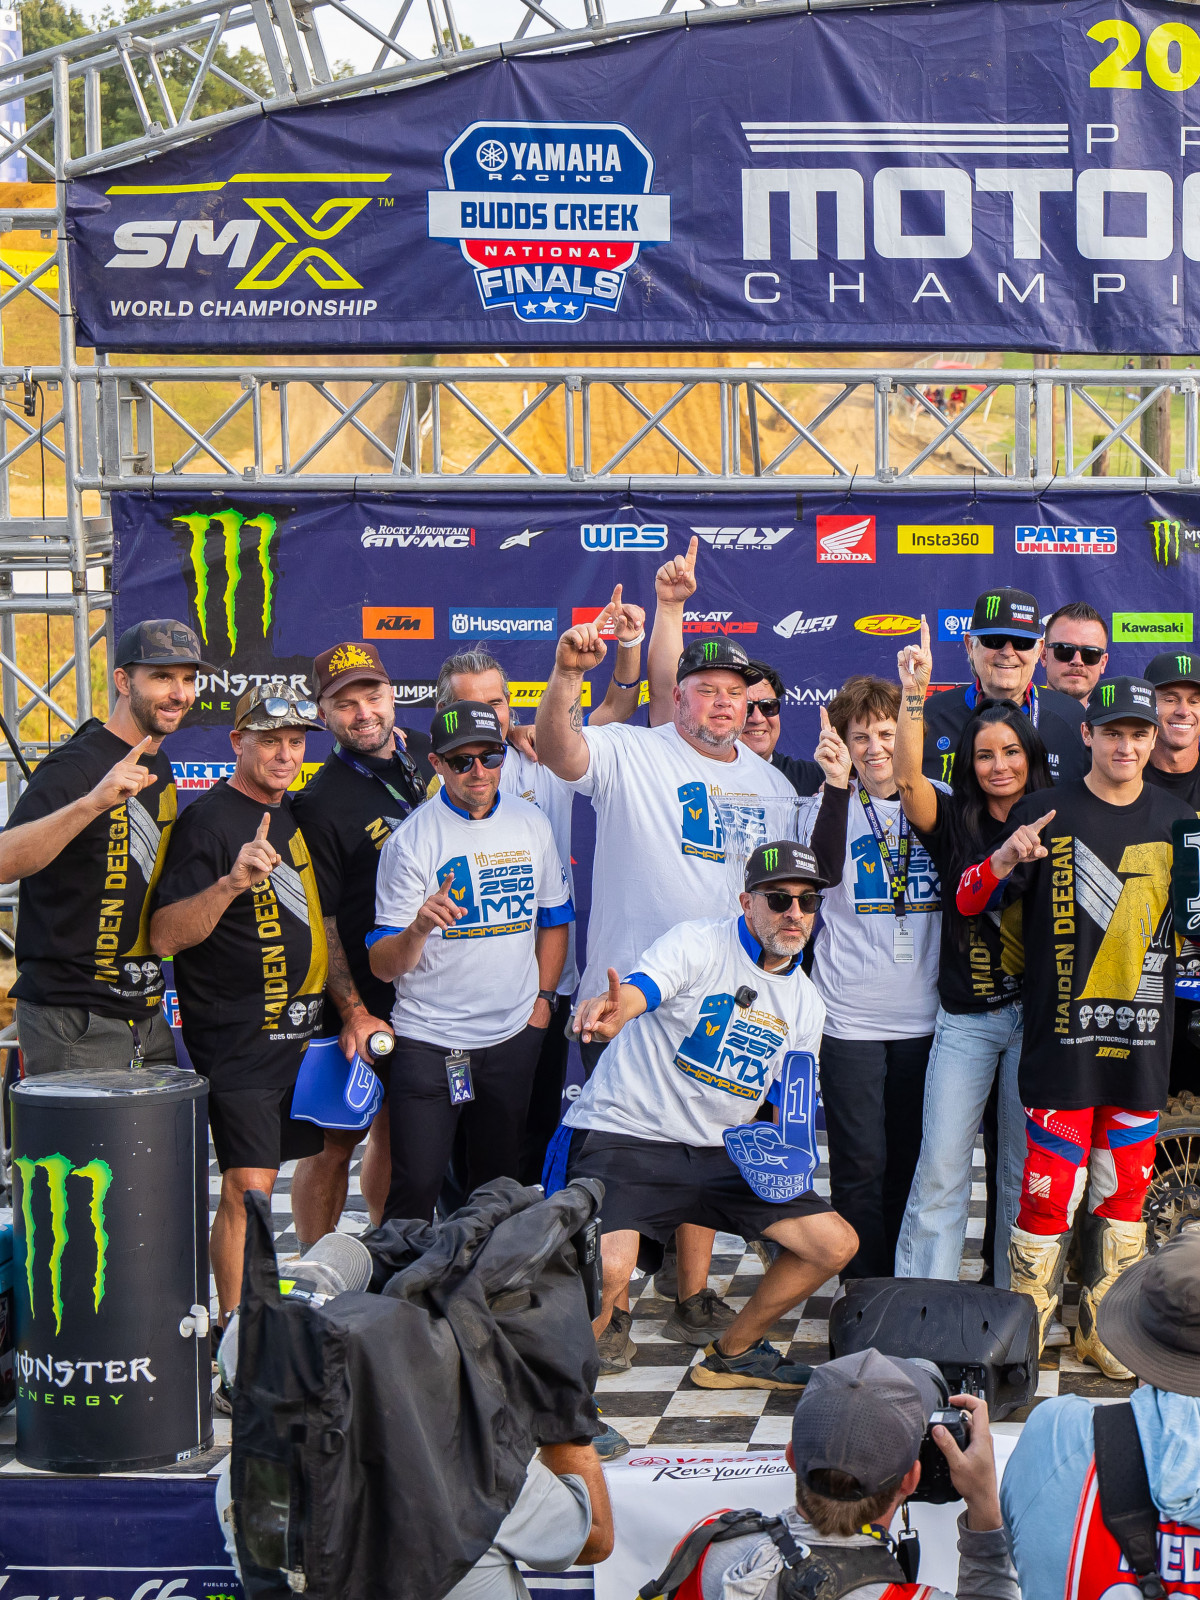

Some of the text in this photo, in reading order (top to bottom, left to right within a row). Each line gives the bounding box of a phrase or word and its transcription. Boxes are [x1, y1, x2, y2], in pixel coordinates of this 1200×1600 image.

[510, 143, 622, 172] YAMAHA
[488, 173, 615, 183] RACING
[461, 202, 638, 232] BUDDS CREEK
[485, 245, 617, 260] NATIONAL
[484, 267, 621, 300] FINALS
[110, 299, 378, 317] WORLD CHAMPIONSHIP
[379, 525, 469, 535] ROCKY MOUNTAIN
[582, 525, 667, 550] WPS
[690, 527, 794, 545] FLY
[1016, 526, 1116, 543] PARTS
[912, 532, 979, 548] Insta360
[1016, 541, 1116, 554] UNLIMITED
[820, 553, 872, 561] HONDA
[376, 616, 420, 630] KTM
[470, 617, 553, 633] Husqvarna
[797, 615, 838, 630] UFO
[855, 616, 922, 632] FMF
[1121, 621, 1184, 634] Kawasaki
[196, 670, 312, 696] ONSTER
[171, 763, 236, 777] ARTS
[105, 800, 128, 889] DEEGA
[479, 865, 533, 878] 2025
[479, 877, 534, 895] 250
[1051, 836, 1075, 935] DEEGAN
[481, 893, 535, 922] MX
[445, 921, 531, 939] CHAMPION
[262, 946, 288, 1030] HAIDEN
[1054, 944, 1075, 1034] HAIDEN
[732, 1020, 783, 1047] 2025
[717, 1049, 769, 1087] MX
[676, 1059, 762, 1100] CHAMPION
[788, 1078, 807, 1123] 1
[18, 1386, 124, 1406] ENERGY
[652, 1466, 753, 1482] Revs Your
